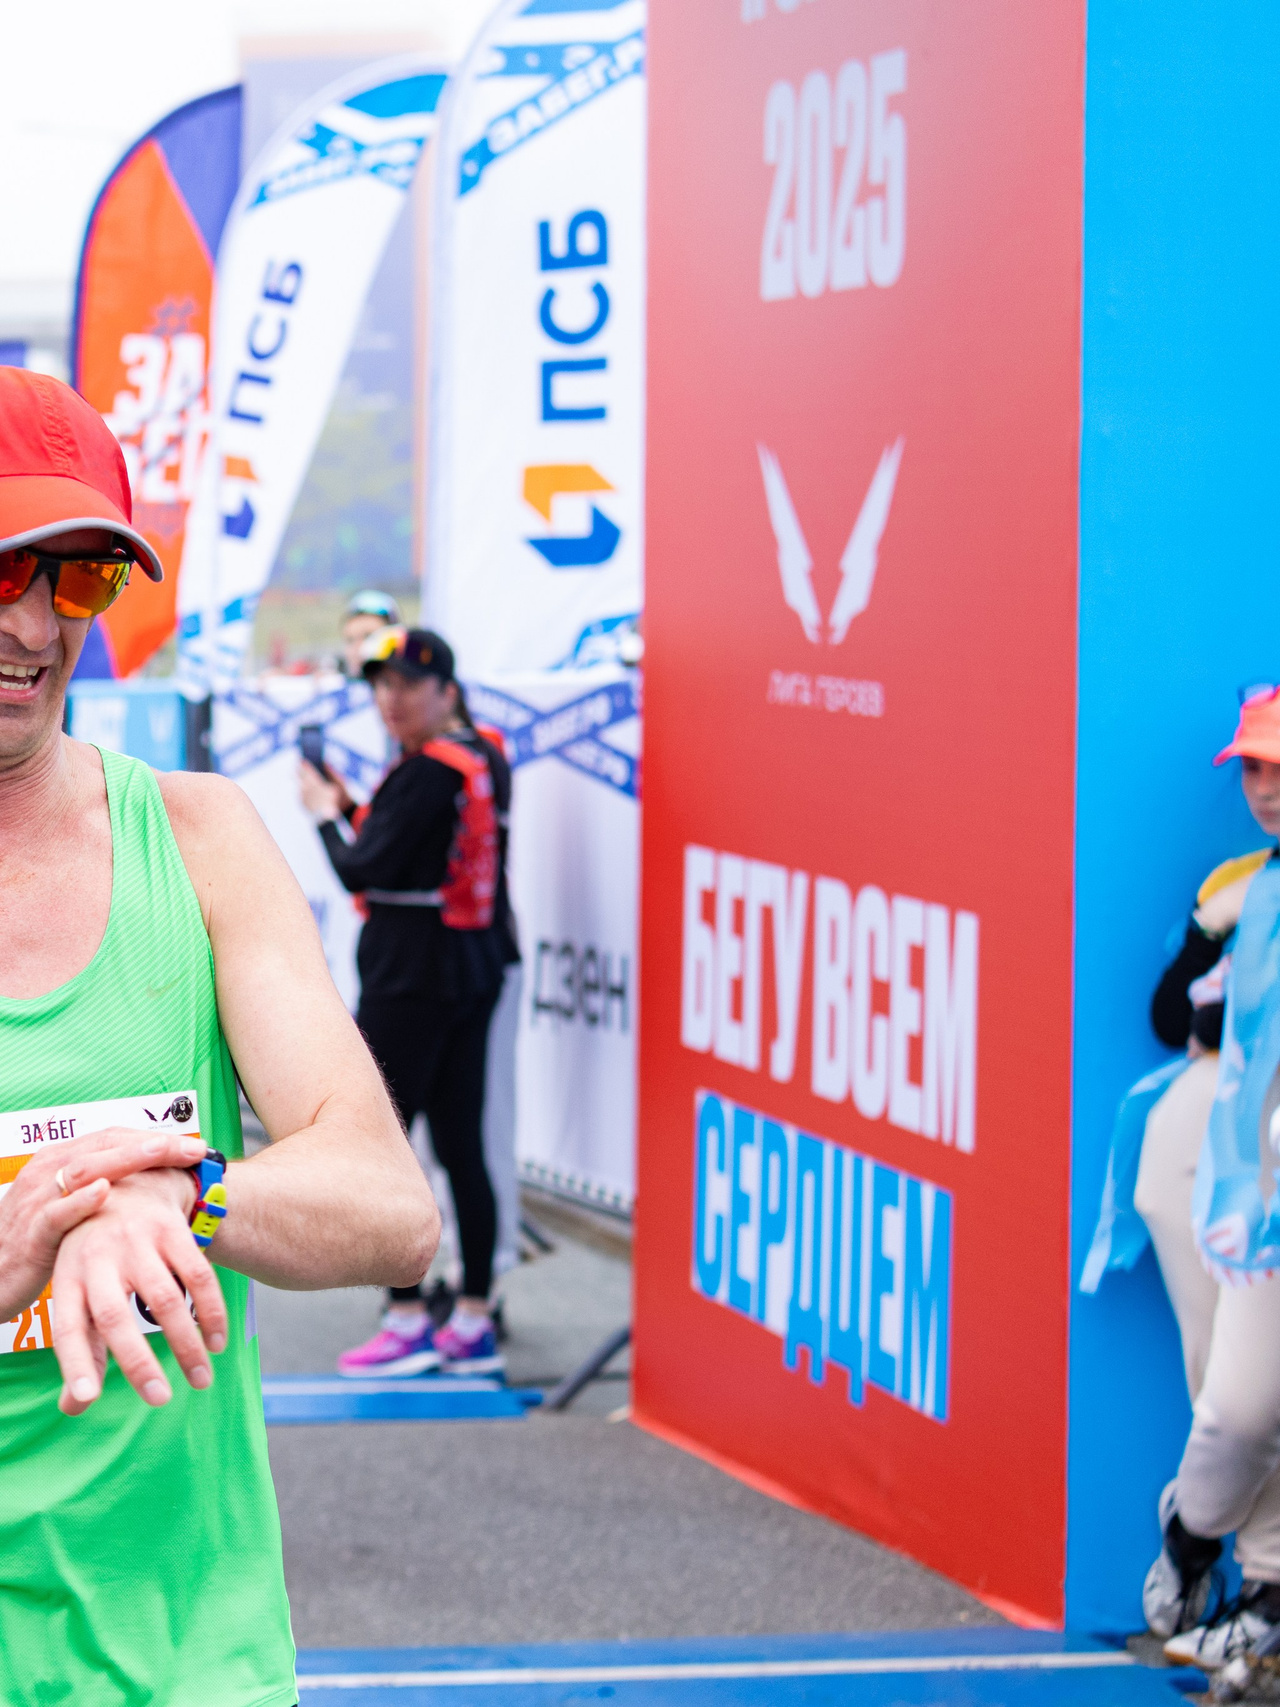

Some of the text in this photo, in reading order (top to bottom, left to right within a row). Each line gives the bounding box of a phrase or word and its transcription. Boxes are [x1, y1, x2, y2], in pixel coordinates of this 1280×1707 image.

[760, 47, 908, 302] 2025
[228, 259, 304, 424] ПСБ
[540, 208, 610, 422] ПСБ
[681, 843, 810, 1083] БЕГУ
[812, 873, 980, 1155] ВСЕМ
[694, 1091, 952, 1424] СЕРДЦЕМ
